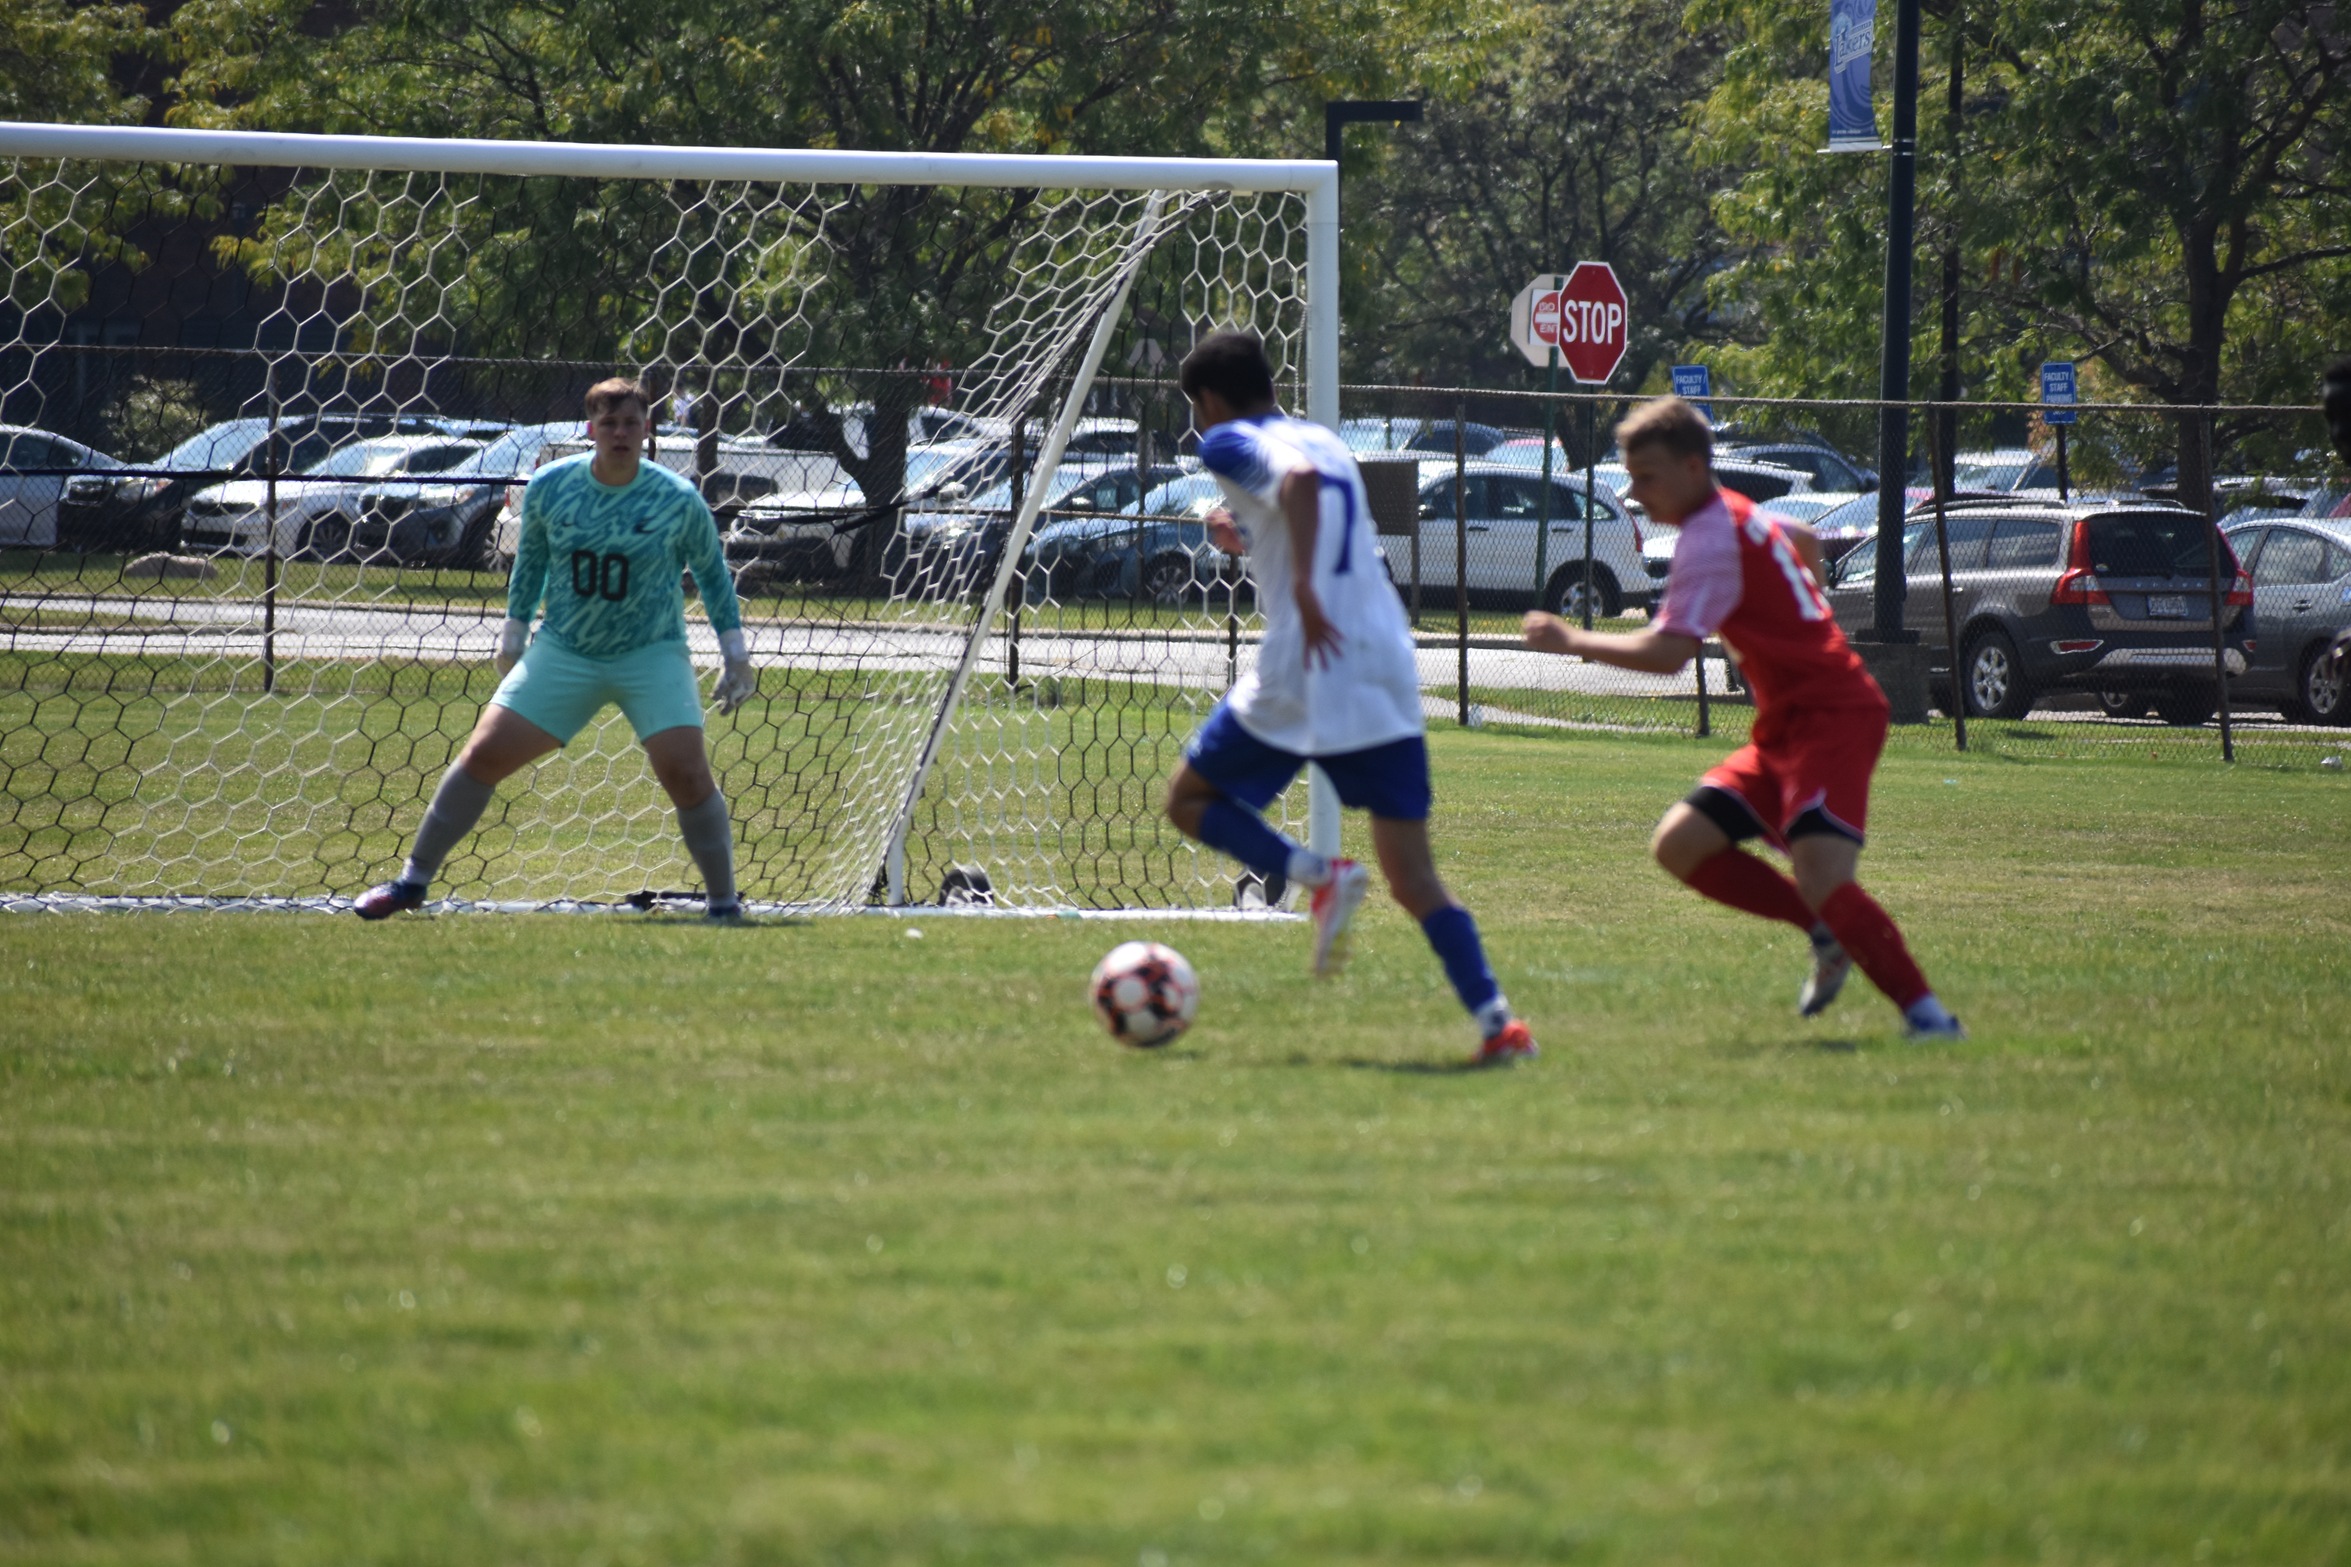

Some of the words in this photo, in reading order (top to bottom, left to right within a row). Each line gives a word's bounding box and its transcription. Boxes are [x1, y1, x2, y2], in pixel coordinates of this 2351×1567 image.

[1539, 302, 1555, 311] DO
[1562, 299, 1622, 345] STOP
[1540, 323, 1558, 333] ENT
[1676, 375, 1702, 384] FACULTY
[2045, 372, 2069, 381] FACULTY
[1682, 386, 1701, 395] STAFF
[2049, 383, 2068, 392] STAFF
[572, 549, 629, 602] 00
